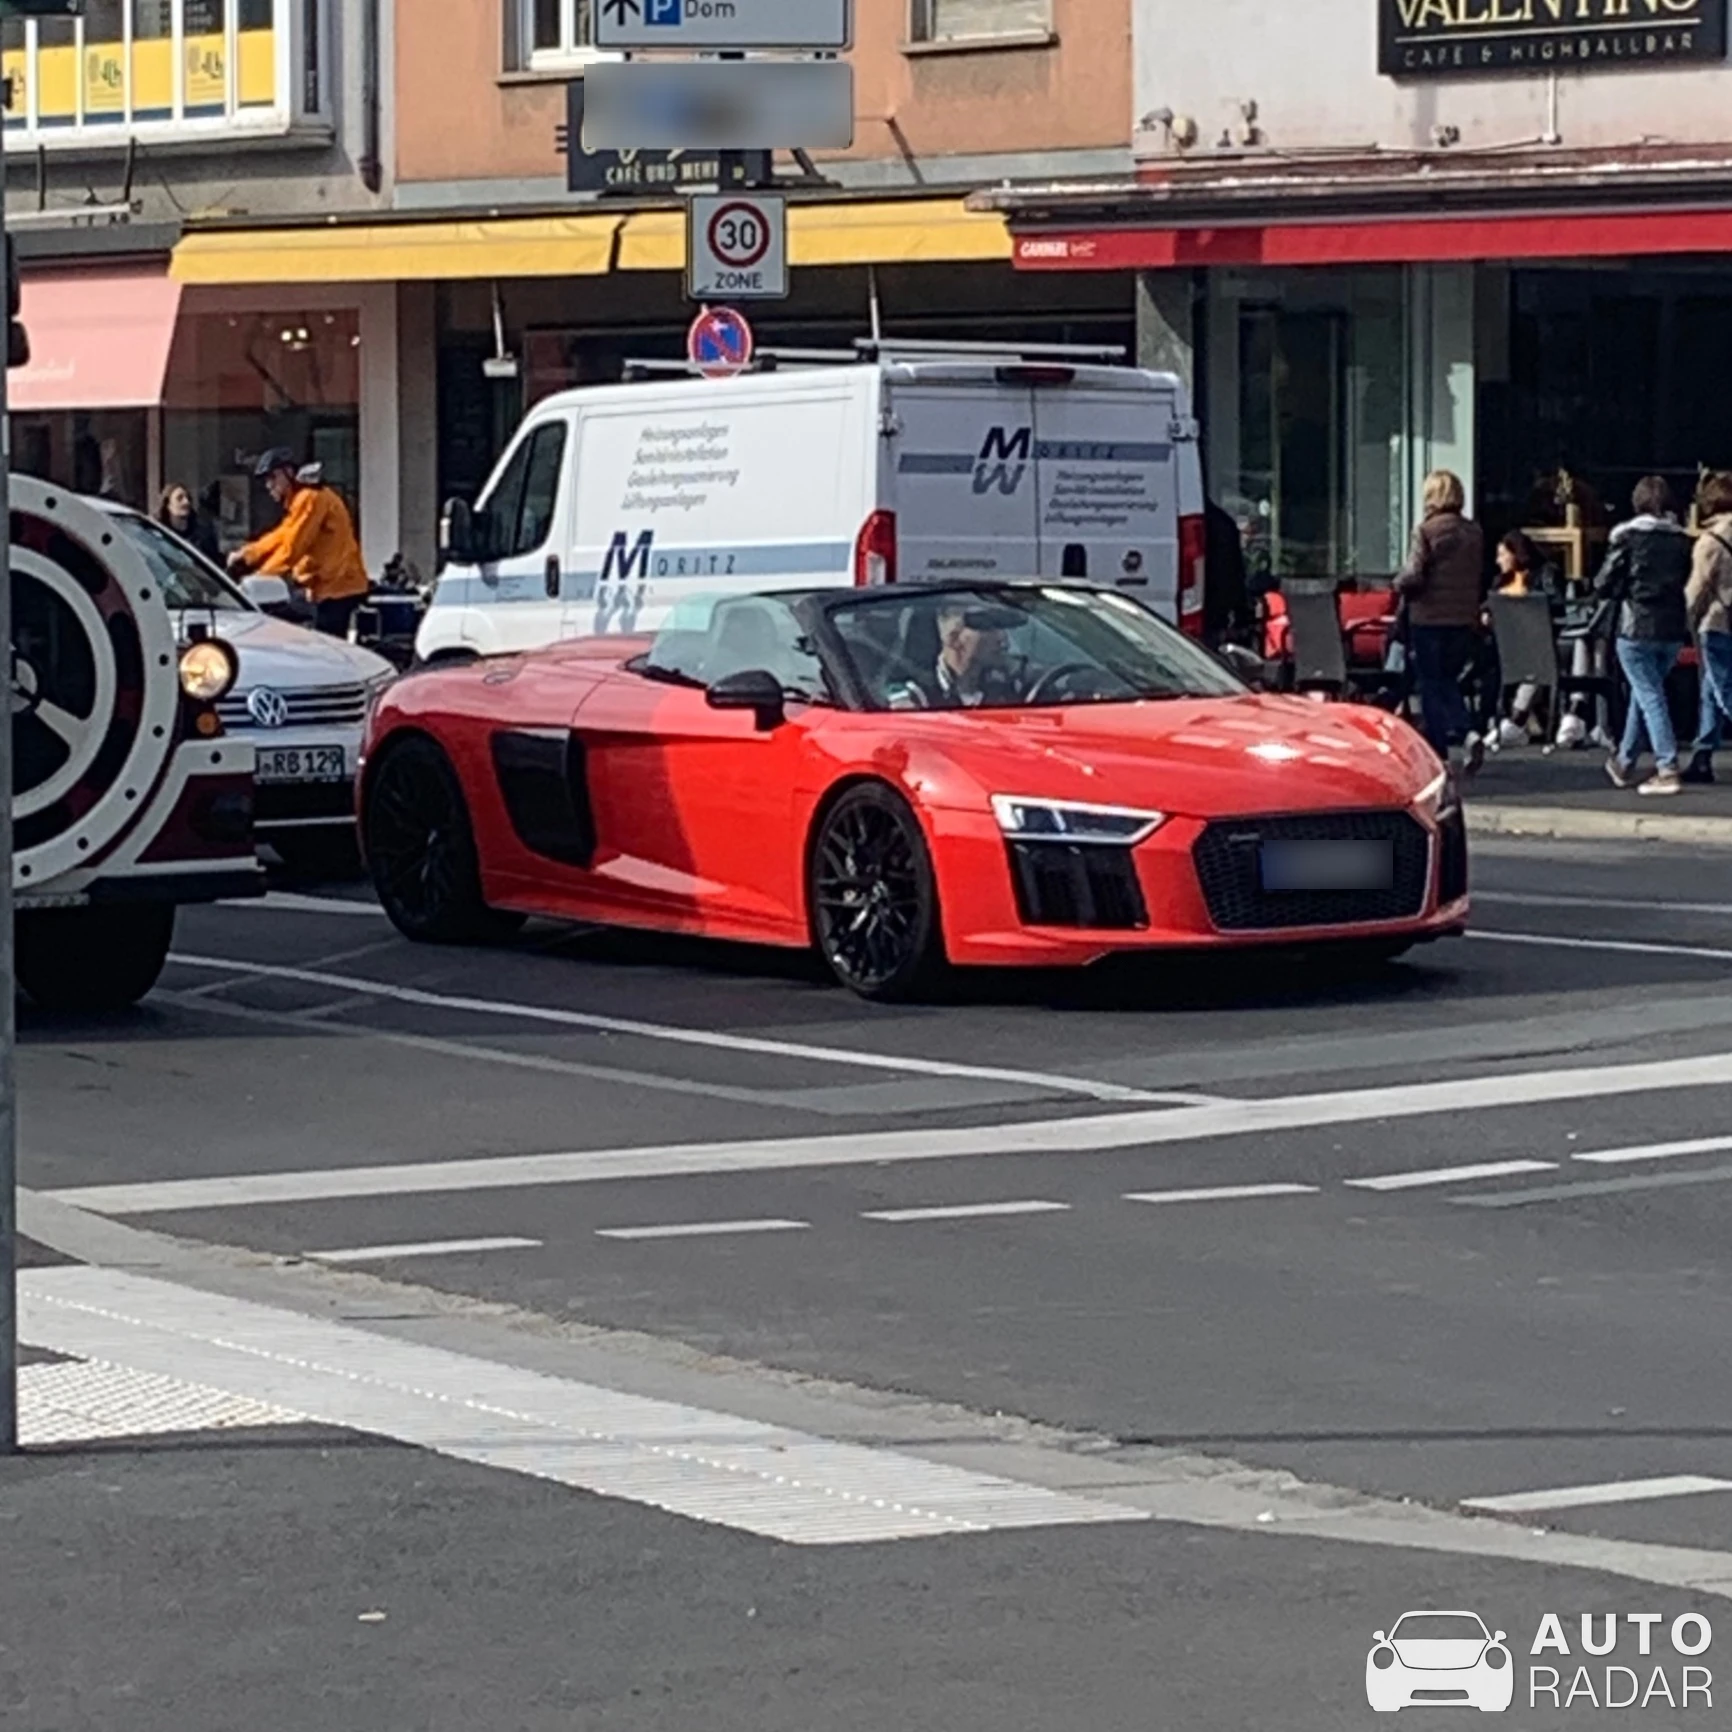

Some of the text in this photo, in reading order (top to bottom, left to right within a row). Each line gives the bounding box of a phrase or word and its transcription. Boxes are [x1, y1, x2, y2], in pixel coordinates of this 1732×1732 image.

[684, 0, 736, 18] Dom
[1396, 0, 1697, 28] VALEN
[719, 219, 757, 251] 30
[714, 271, 763, 290] ZONE
[273, 751, 341, 774] RB 129
